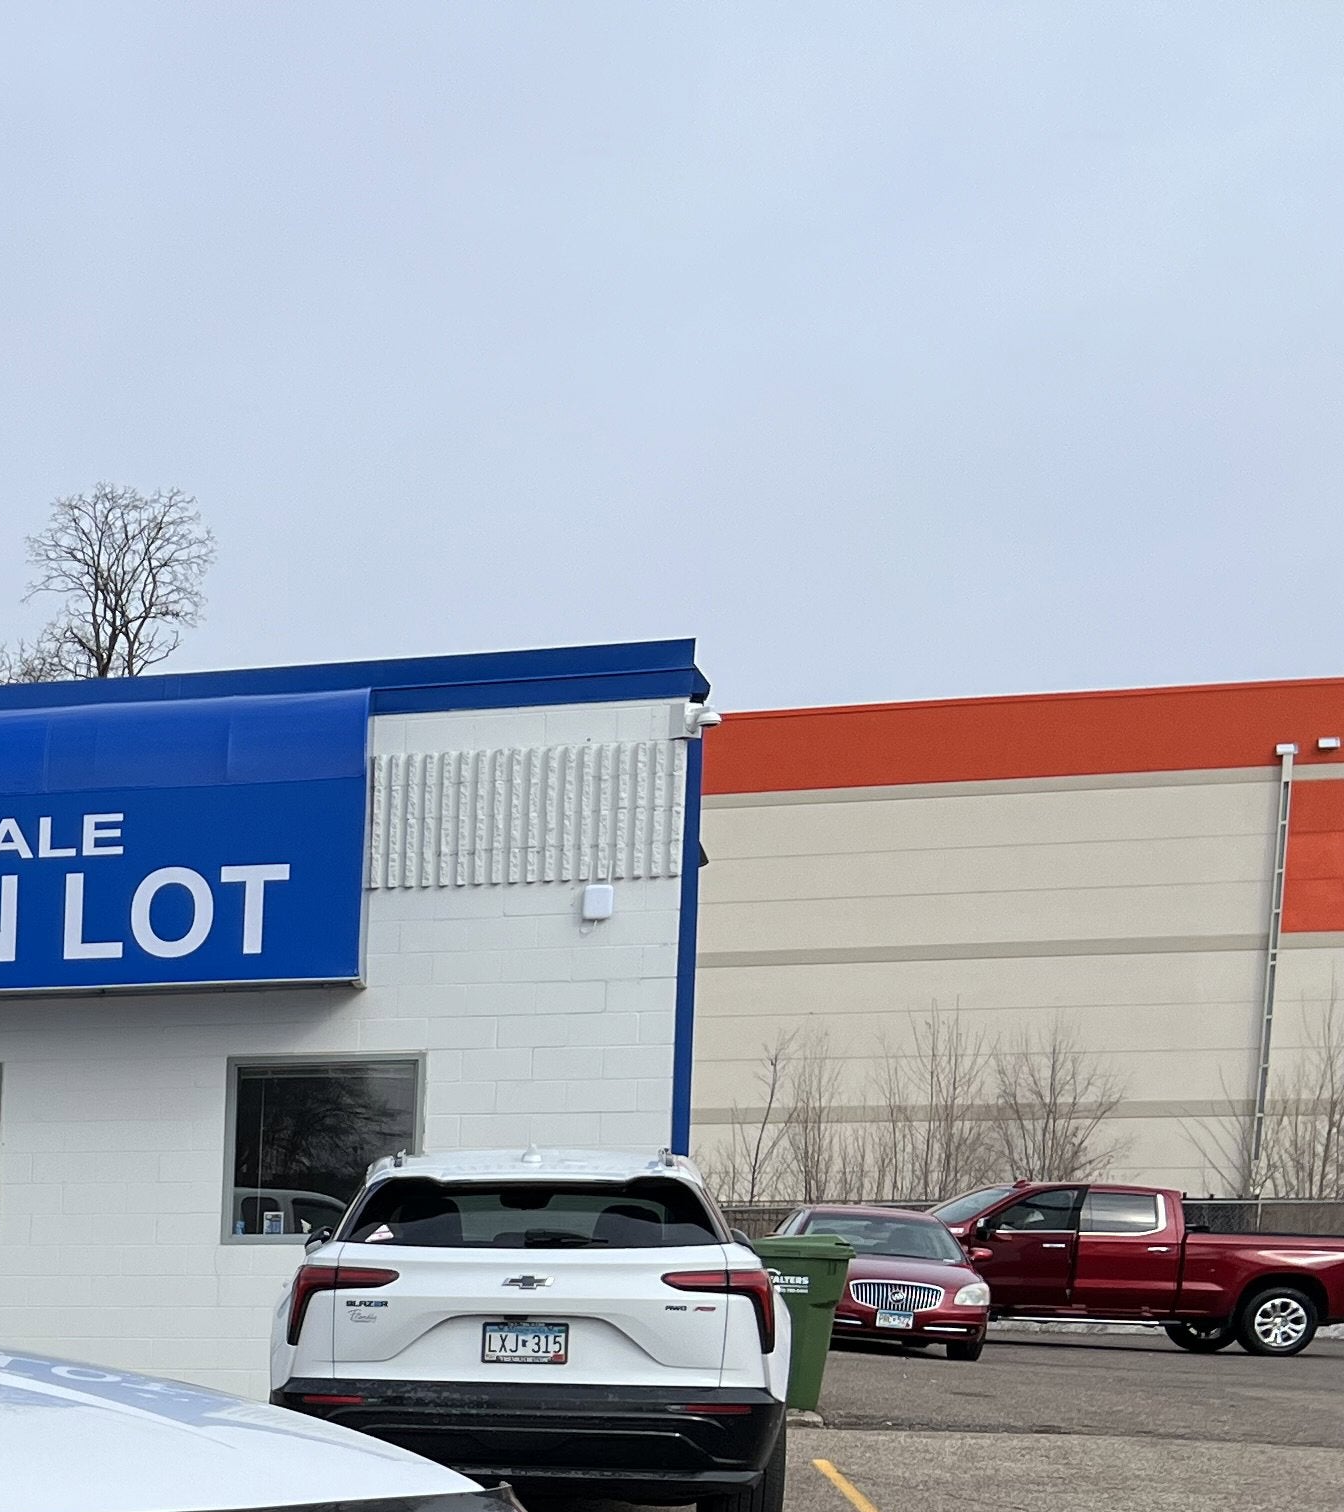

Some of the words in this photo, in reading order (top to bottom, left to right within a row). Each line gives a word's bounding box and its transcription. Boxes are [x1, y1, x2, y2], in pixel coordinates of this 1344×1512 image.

[63, 863, 291, 960] LOT
[770, 1275, 810, 1285] ALTERS
[345, 1300, 389, 1308] BLAZER
[488, 1333, 519, 1354] LXJ
[531, 1334, 563, 1355] 315
